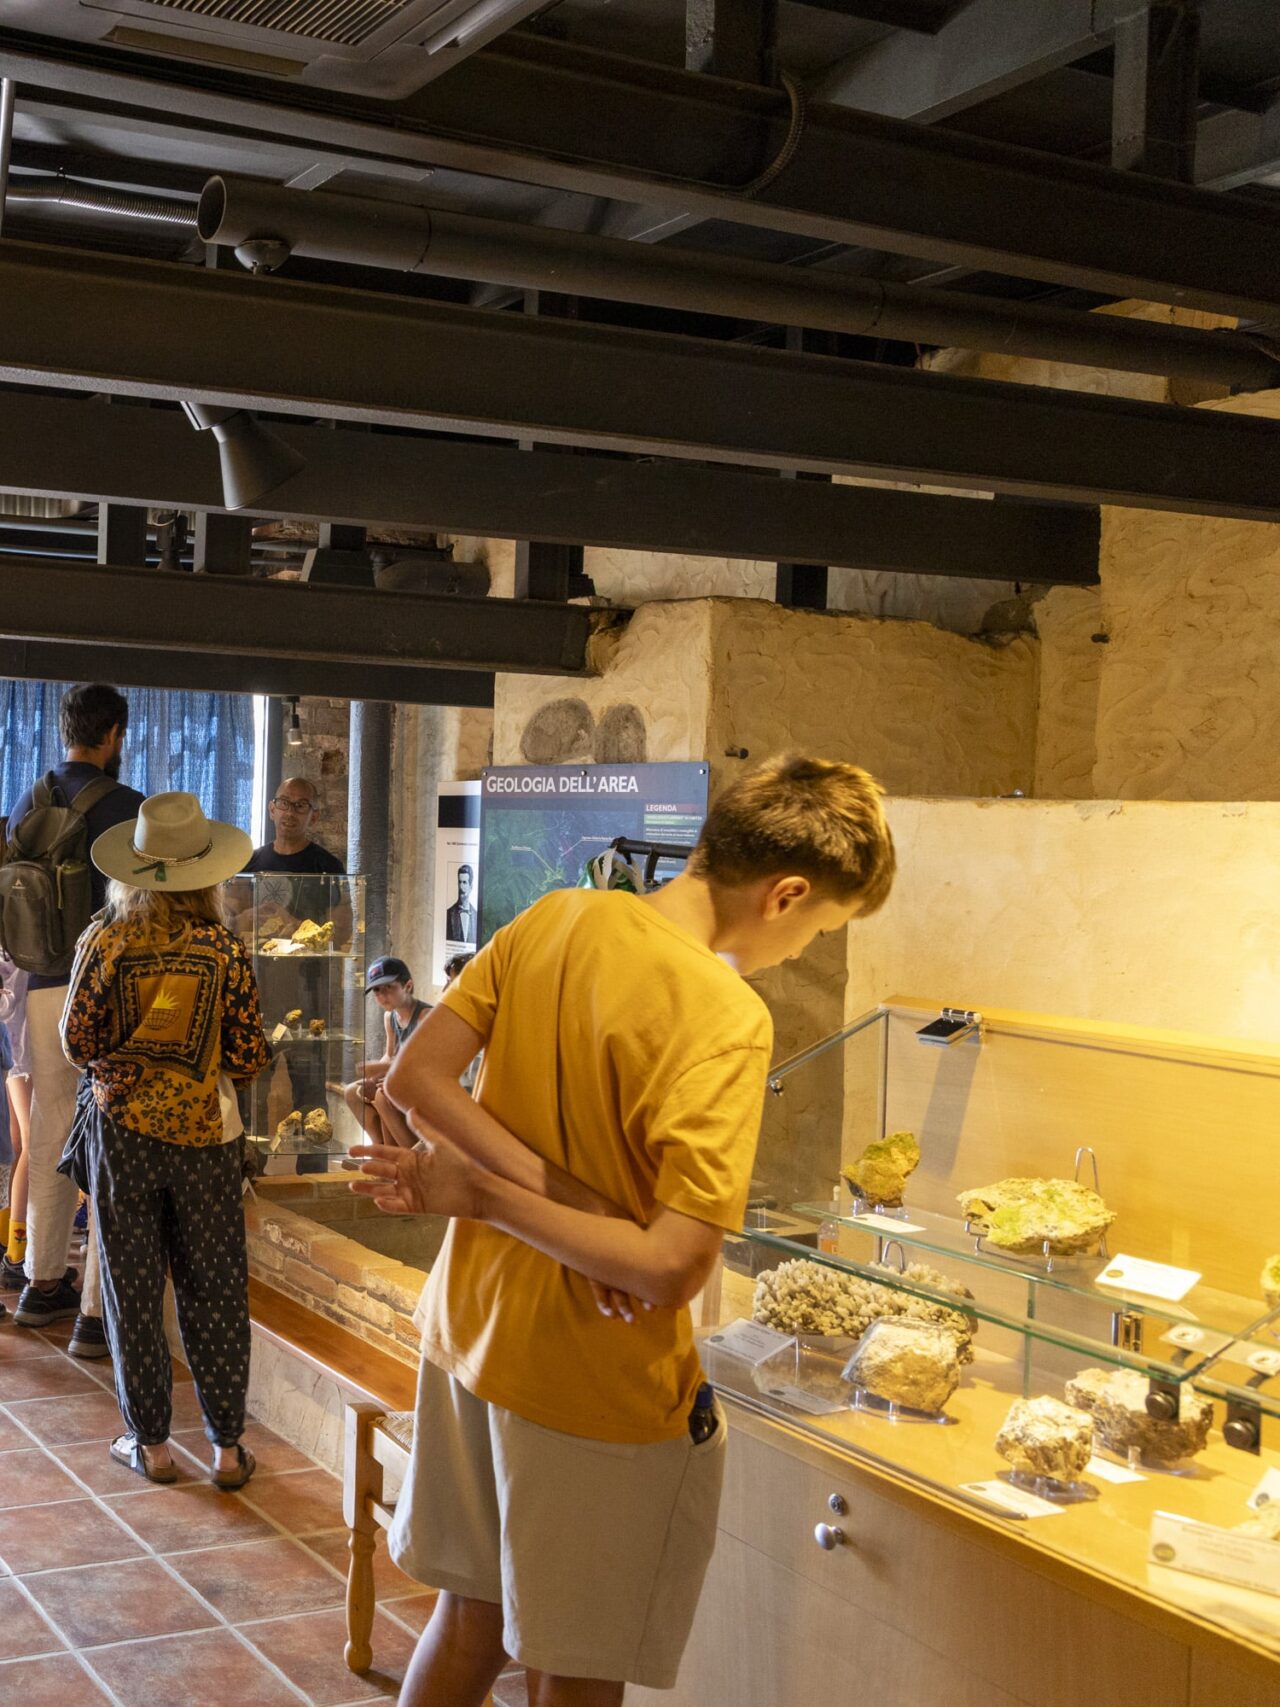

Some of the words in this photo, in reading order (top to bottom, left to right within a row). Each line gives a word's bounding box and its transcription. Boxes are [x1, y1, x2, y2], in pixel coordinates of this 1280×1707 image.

[487, 776, 556, 793] GEOLOGIA
[559, 776, 639, 793] DELL'AREA
[646, 804, 677, 812] LEGENDA
